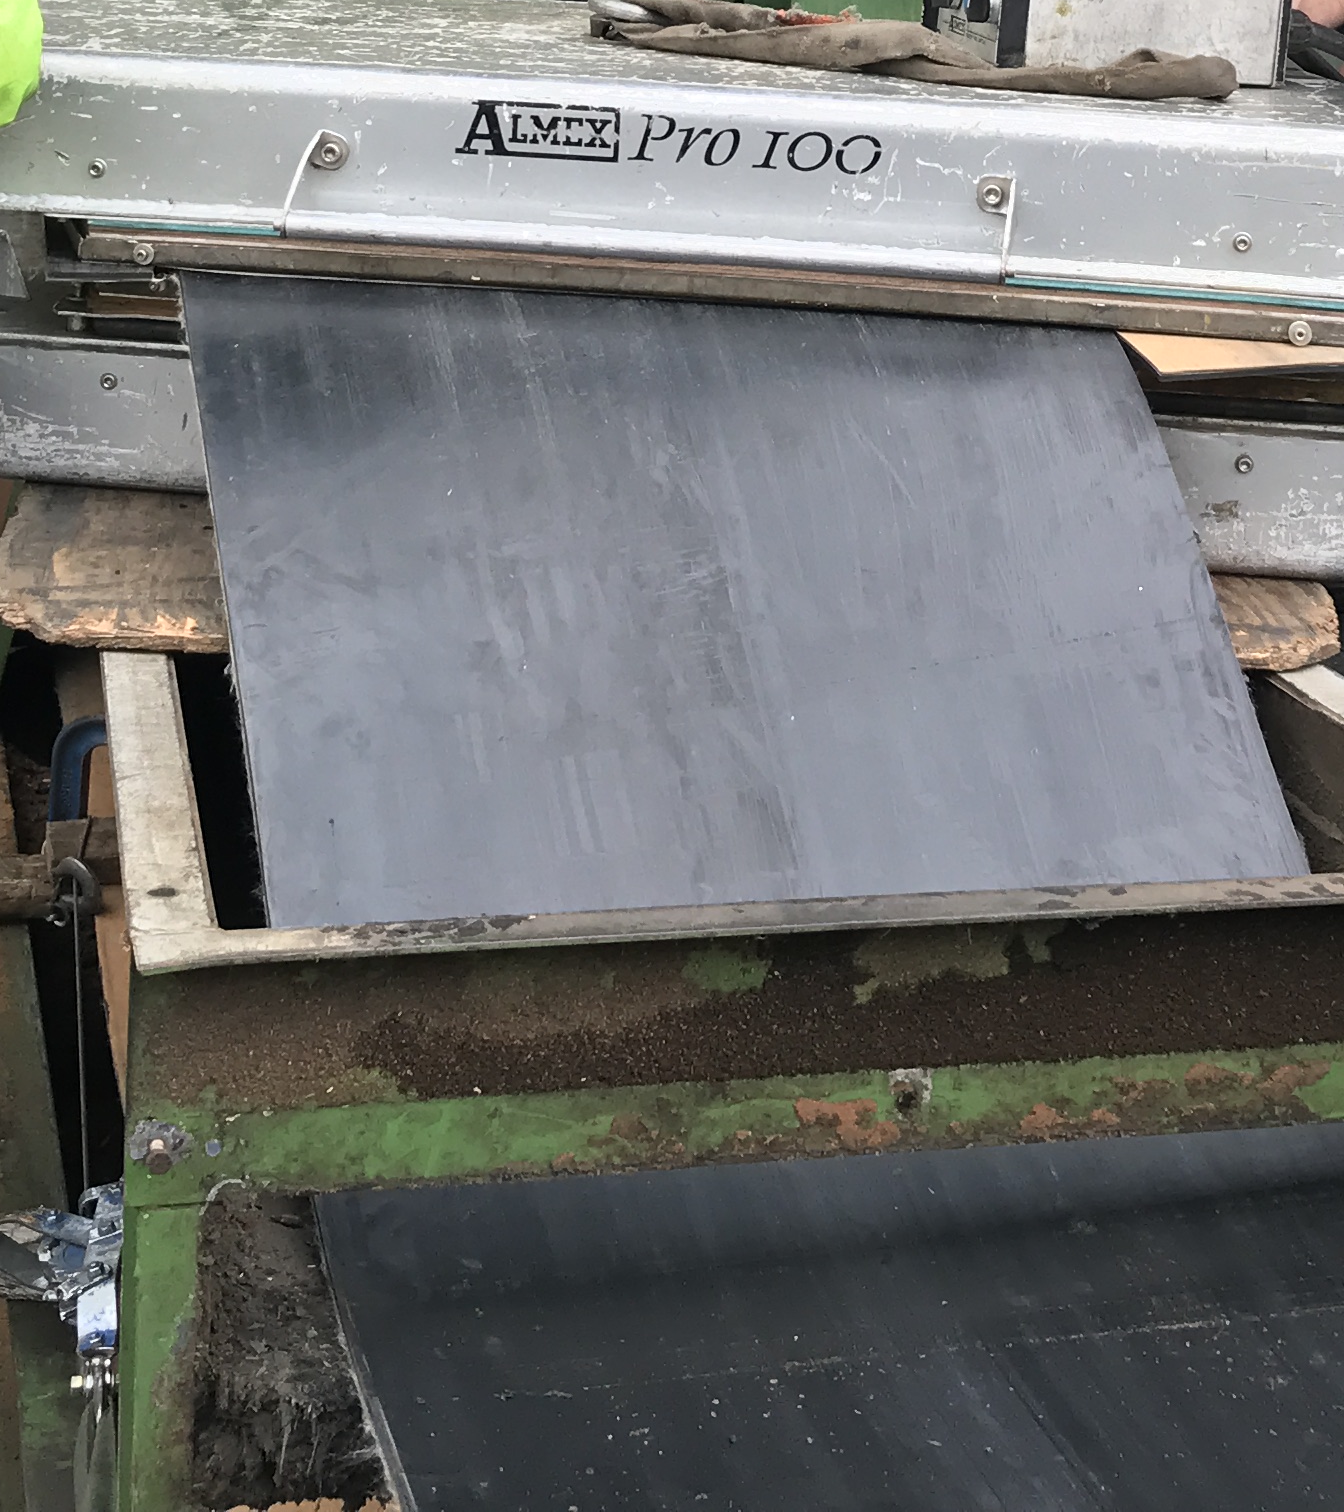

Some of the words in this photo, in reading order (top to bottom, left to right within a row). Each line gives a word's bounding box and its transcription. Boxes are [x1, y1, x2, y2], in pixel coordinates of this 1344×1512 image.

[455, 100, 619, 163] ALMEX
[627, 113, 740, 166] Pro
[752, 130, 882, 175] 100
